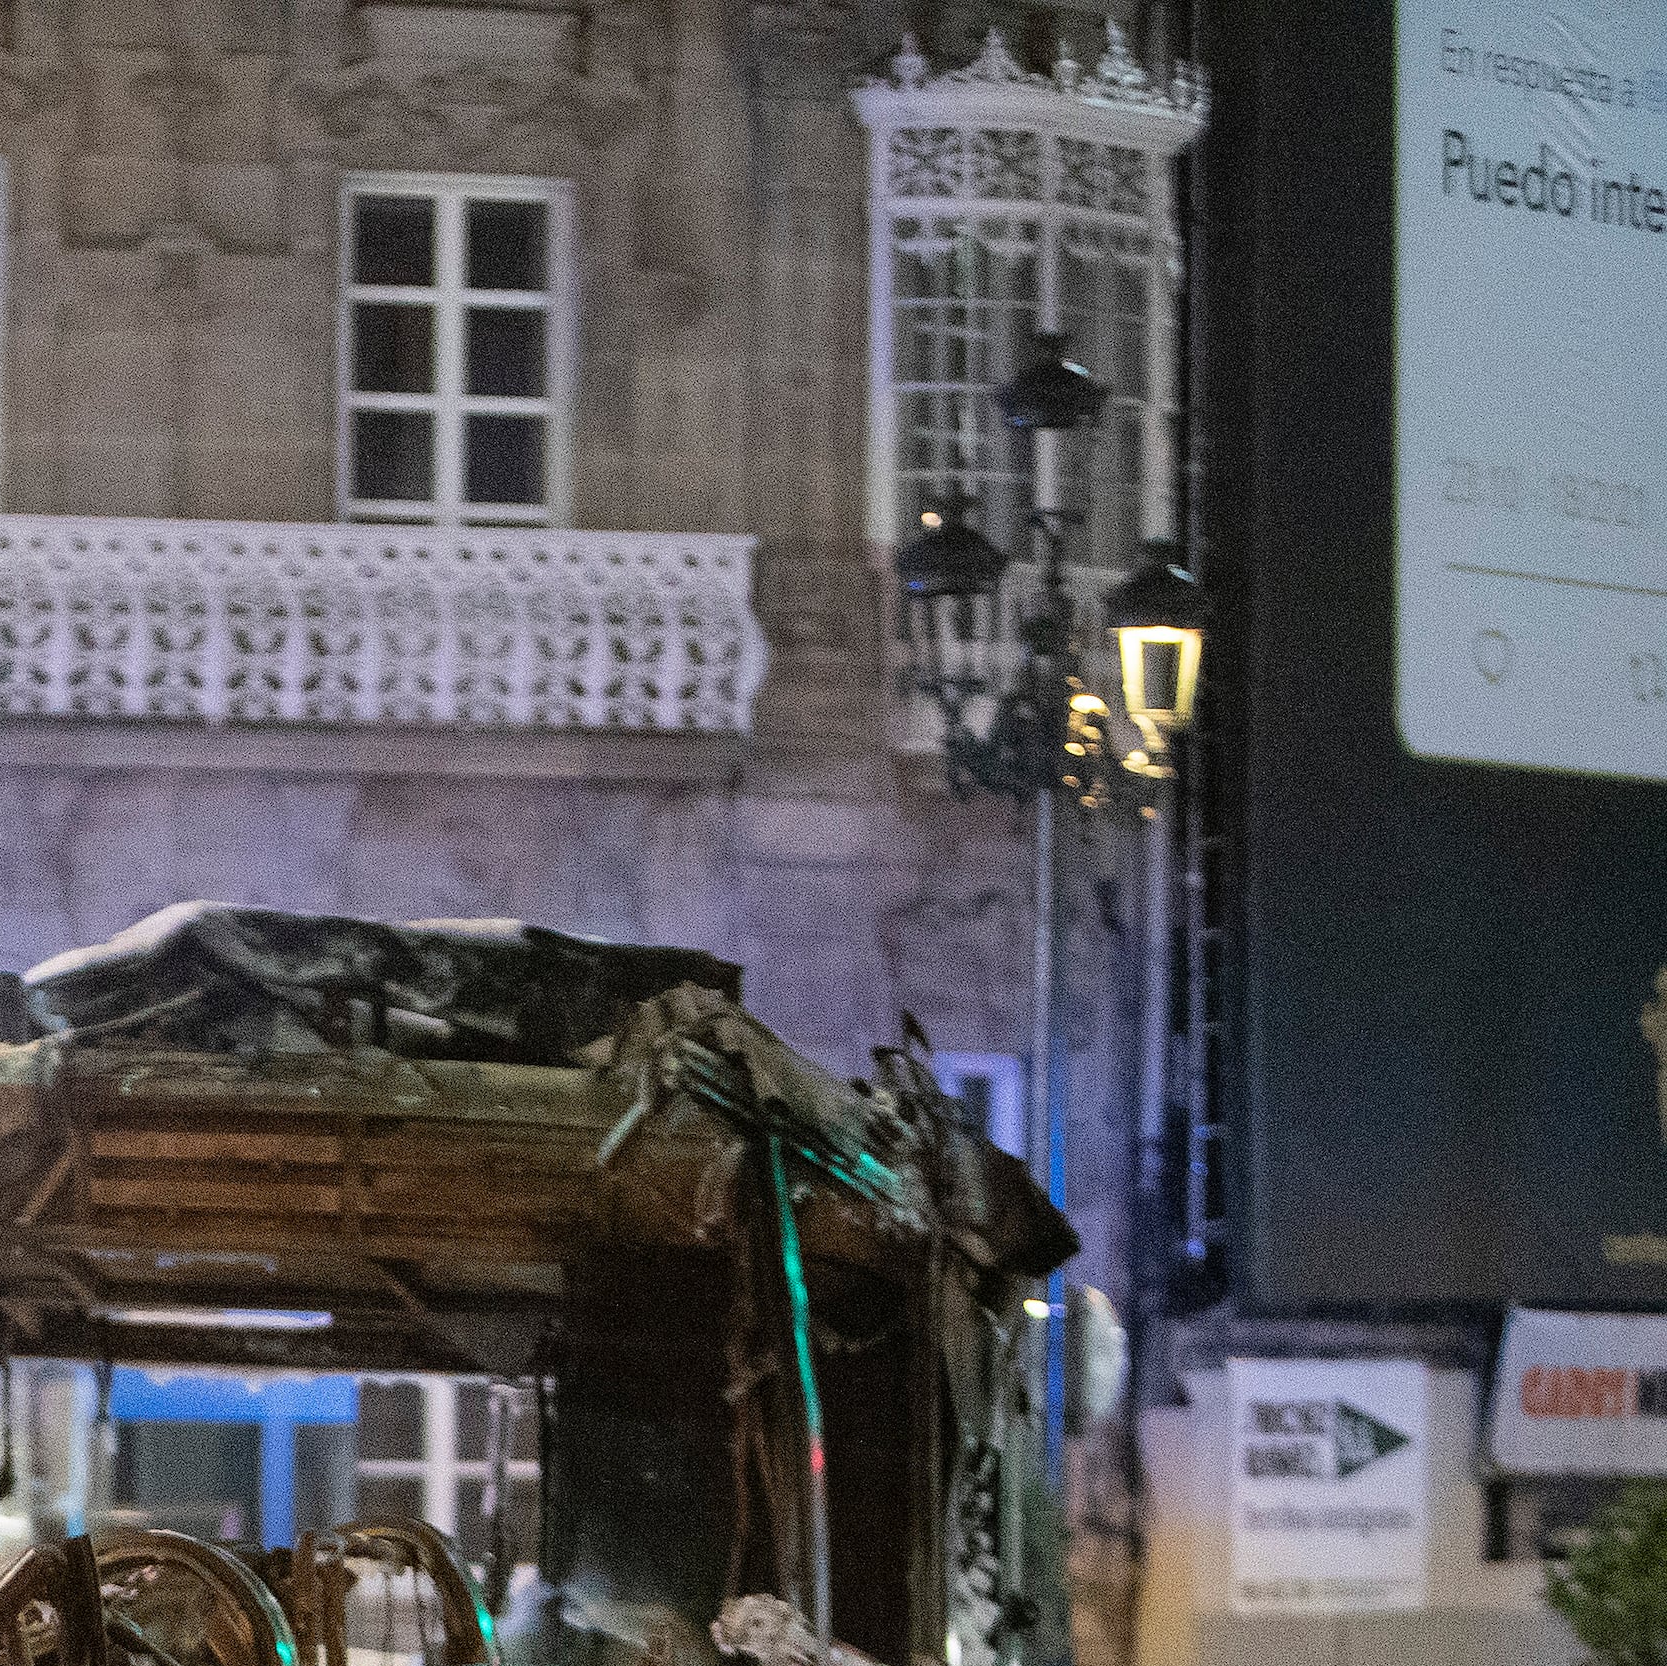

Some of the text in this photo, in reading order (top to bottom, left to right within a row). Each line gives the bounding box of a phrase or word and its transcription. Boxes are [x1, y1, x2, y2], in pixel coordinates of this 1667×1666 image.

[1441, 28, 1475, 78] En
[1482, 50, 1614, 106] respuesta
[1441, 127, 1667, 234] Puedo inte
